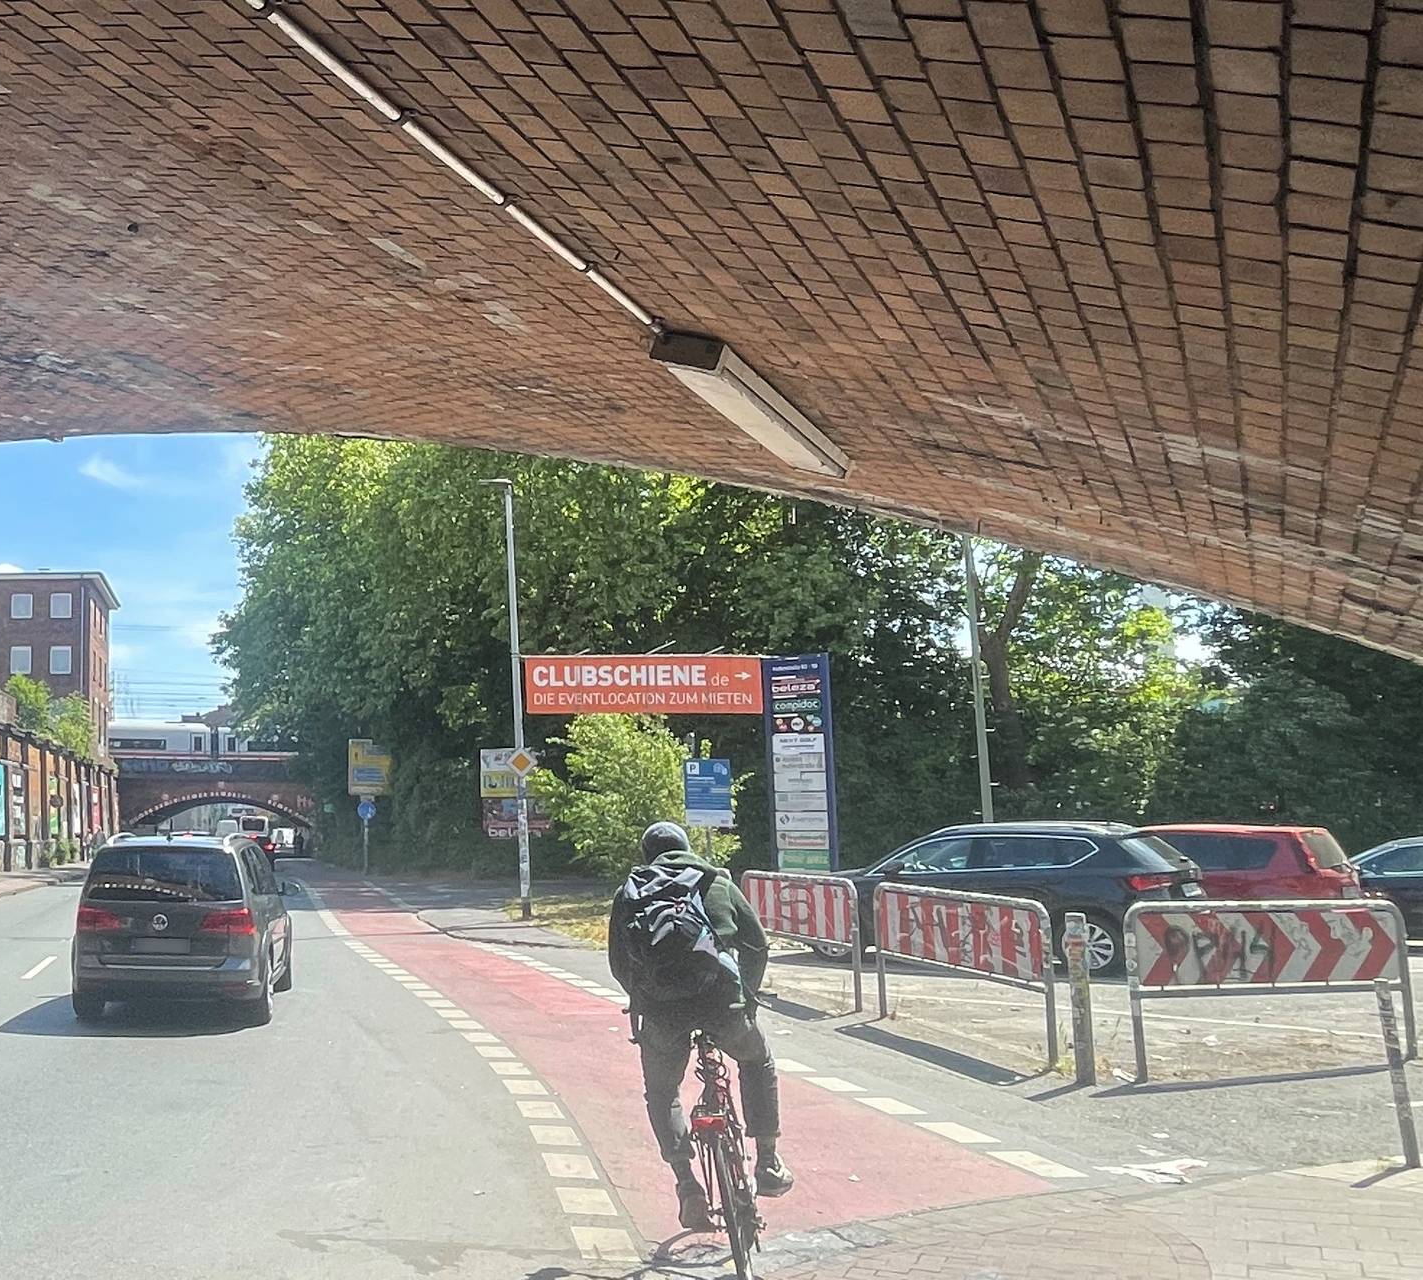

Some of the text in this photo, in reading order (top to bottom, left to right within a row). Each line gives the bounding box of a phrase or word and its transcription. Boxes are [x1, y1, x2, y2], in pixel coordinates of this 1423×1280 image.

[771, 683, 816, 693] beleza
[533, 692, 753, 705] DIE EVENTLOCATION ZUM MIETEN
